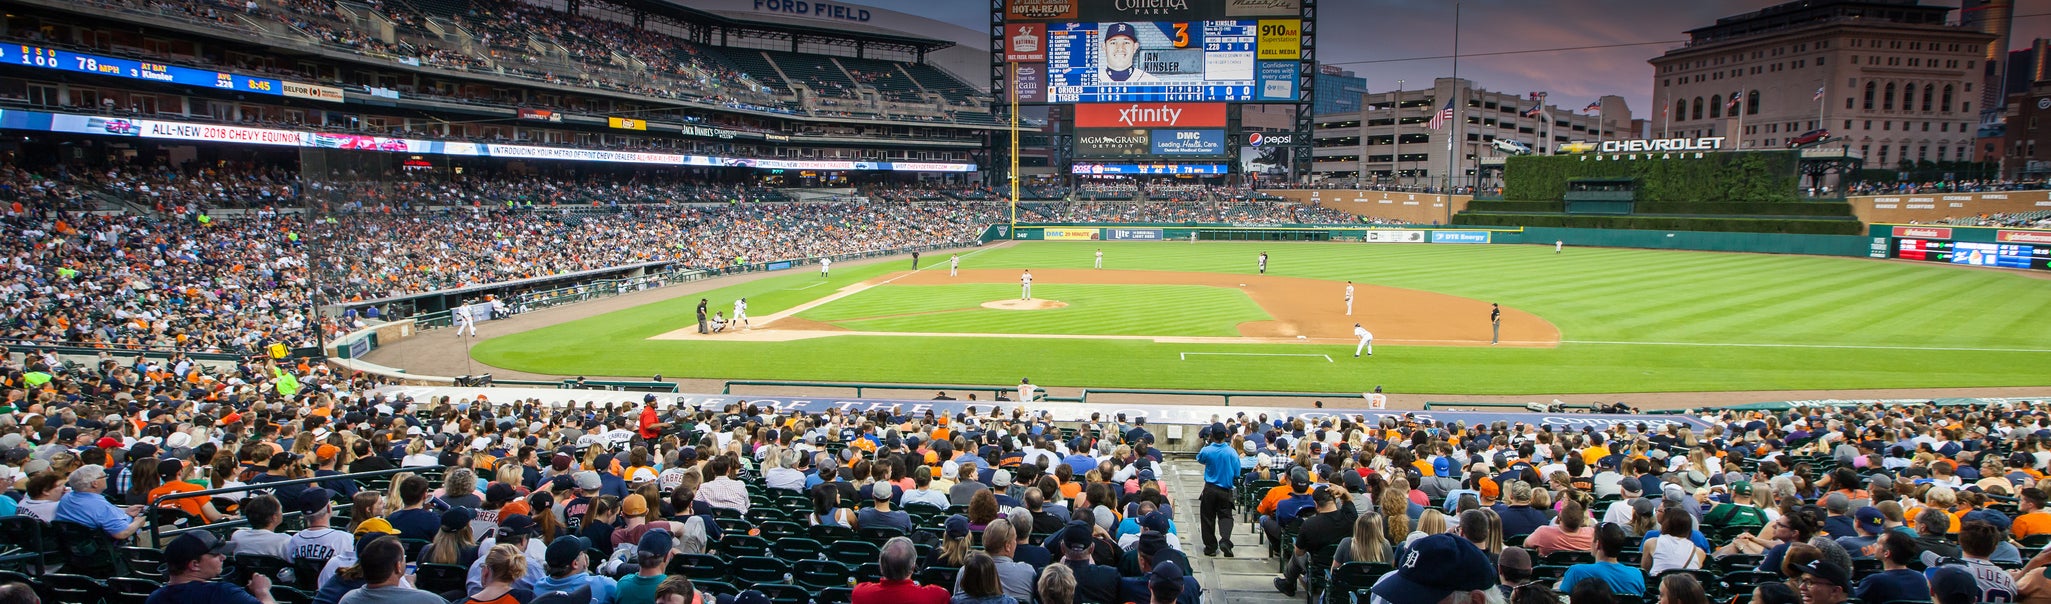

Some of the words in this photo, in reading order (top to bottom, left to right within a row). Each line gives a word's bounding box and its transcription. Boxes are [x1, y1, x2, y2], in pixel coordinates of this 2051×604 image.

[754, 0, 808, 13] FORD
[815, 3, 870, 22] FIELD
[1012, 4, 1071, 14] HOT-N-READY
[1262, 24, 1285, 36] 910
[1173, 23, 1189, 48] 3
[21, 45, 29, 54] B
[35, 47, 42, 55] S
[22, 55, 31, 65] 1
[35, 56, 45, 66] 0
[48, 58, 58, 68] 0
[1144, 52, 1159, 61] IAN
[76, 56, 98, 71] 78
[99, 64, 120, 74] MPH
[141, 62, 151, 70] AT
[152, 64, 167, 72] BAT
[1144, 62, 1179, 72] KINSLER
[130, 68, 139, 77] 3
[142, 70, 173, 82] Kinsler
[217, 72, 231, 81] AVG
[248, 79, 271, 91] 8:45
[283, 85, 308, 95] BELFOR
[1208, 87, 1214, 95] 1
[1226, 87, 1232, 95] 0
[1243, 87, 1250, 95] 0
[1118, 104, 1182, 126] xfinity
[152, 123, 201, 137] ALL-NEW
[204, 127, 226, 139] 2018
[229, 129, 260, 141] CHEVY
[262, 131, 300, 143] EQUINOX
[682, 125, 695, 135] JACK
[1176, 131, 1201, 139] DMC
[1264, 135, 1291, 145] pepsi
[1603, 136, 1726, 152] CHEVROLET
[493, 145, 536, 156] INTRODUCING
[537, 147, 553, 156] YOUR
[553, 148, 573, 158] METRO
[573, 149, 597, 159] DETROIT
[596, 151, 614, 160] CHEVY
[614, 152, 636, 161] DEALERS
[1580, 152, 1704, 162] FOUNTAIN
[1115, 229, 1130, 239] Lite
[1461, 233, 1485, 241] Energy
[1372, 400, 1381, 408] 21
[1402, 547, 1420, 569] D
